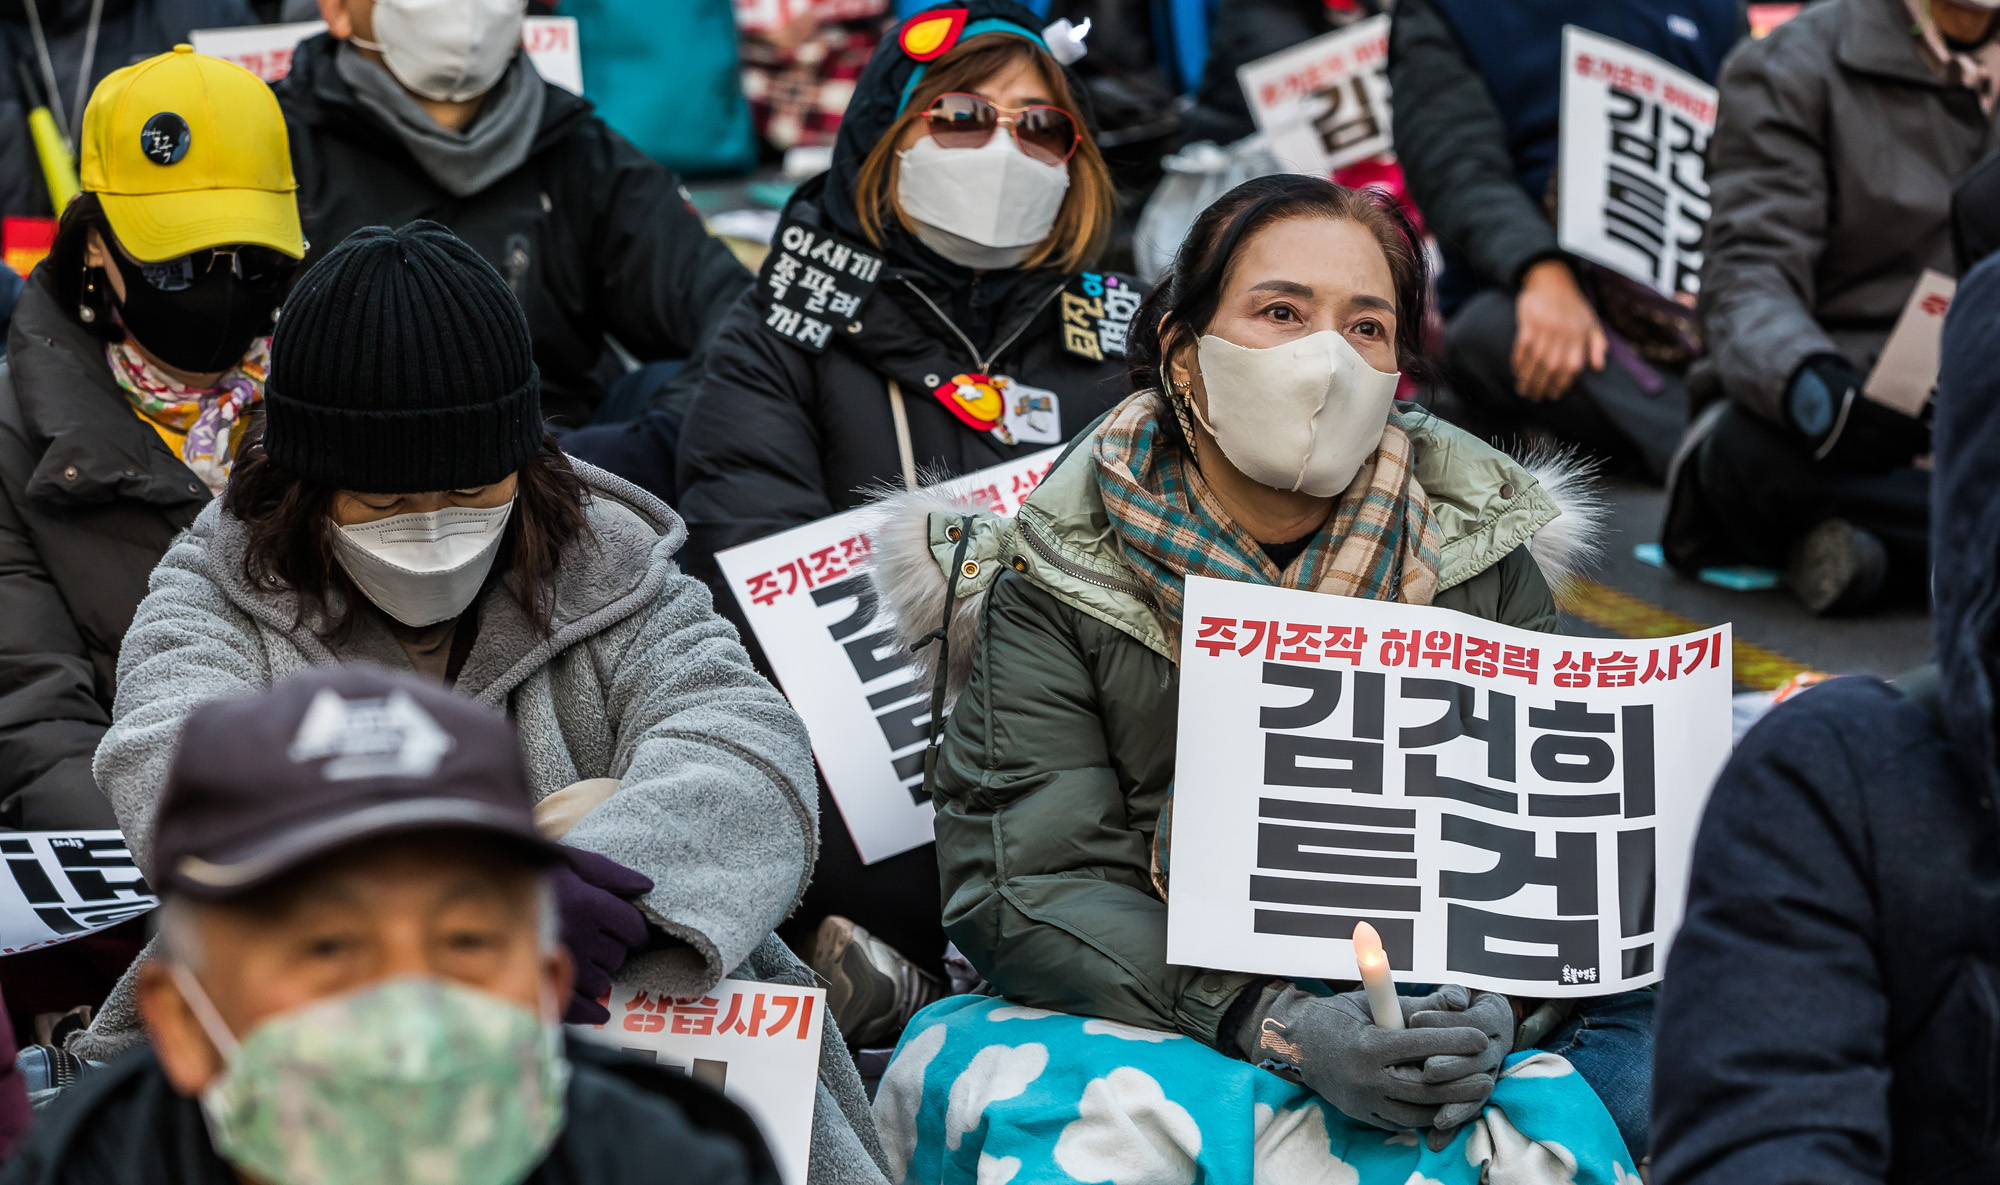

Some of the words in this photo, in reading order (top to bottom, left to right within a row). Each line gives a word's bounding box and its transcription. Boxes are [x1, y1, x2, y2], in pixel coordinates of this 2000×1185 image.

[1195, 616, 1367, 666] 주가조작
[1380, 628, 1540, 685] 허위경력
[1553, 632, 1722, 688] 상습사기
[1259, 662, 1656, 819] 김건희
[1249, 797, 1656, 982] 특검!
[623, 991, 814, 1040] 상습사기
